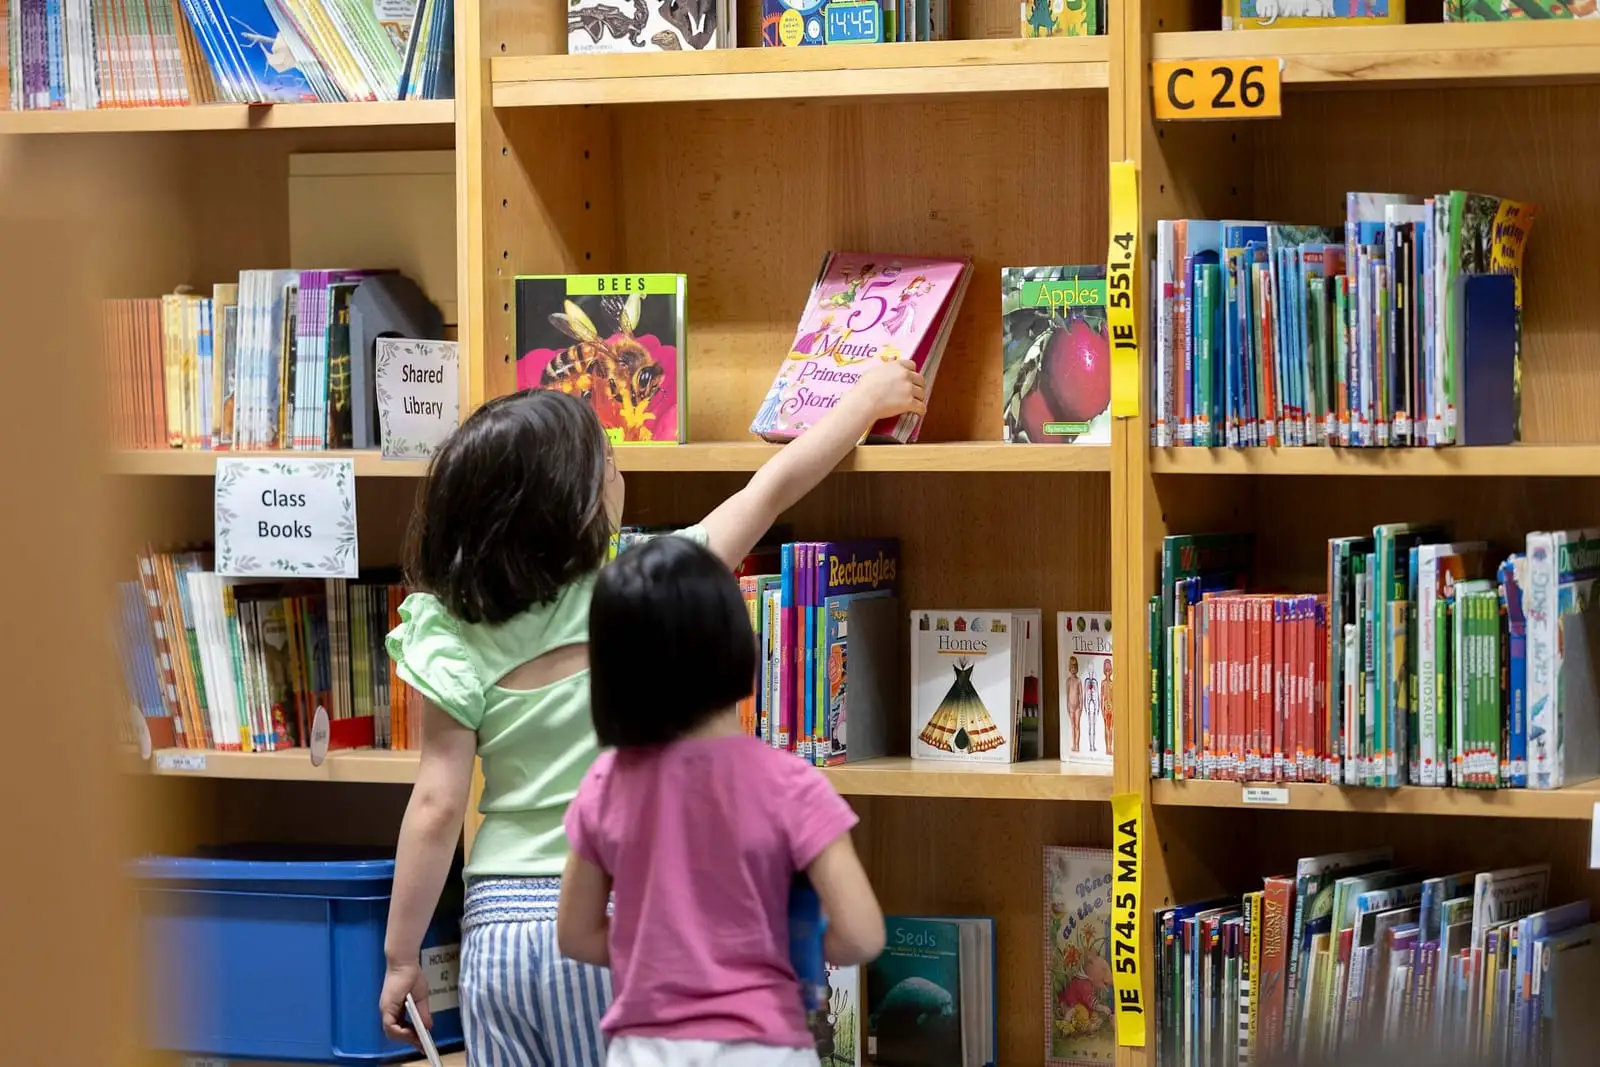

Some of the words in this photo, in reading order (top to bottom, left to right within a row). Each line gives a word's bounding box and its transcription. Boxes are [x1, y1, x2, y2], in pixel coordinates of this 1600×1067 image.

[830, 9, 874, 35] 14:45
[1167, 68, 1195, 110] C
[1211, 65, 1265, 108] 26
[1110, 232, 1134, 308] 551.4
[598, 277, 646, 291] BEES
[846, 279, 896, 333] 5
[1036, 275, 1099, 319] Apples
[814, 334, 878, 359] Minute
[1113, 324, 1137, 350] JE
[402, 364, 444, 384] Shared
[796, 361, 862, 384] Princes
[404, 396, 443, 419] Library
[780, 387, 841, 416] Stori
[261, 489, 306, 507] Class
[258, 520, 312, 538] Books
[829, 551, 896, 588] Rectangles
[938, 635, 988, 651] Homes
[1072, 635, 1093, 651] The
[1096, 636, 1112, 652] Bo
[1423, 661, 1434, 739] DINOSAURS
[1118, 818, 1137, 882] MAA
[895, 927, 937, 947] Seals
[1115, 892, 1136, 974] 574.5
[1119, 989, 1143, 1014] JE
